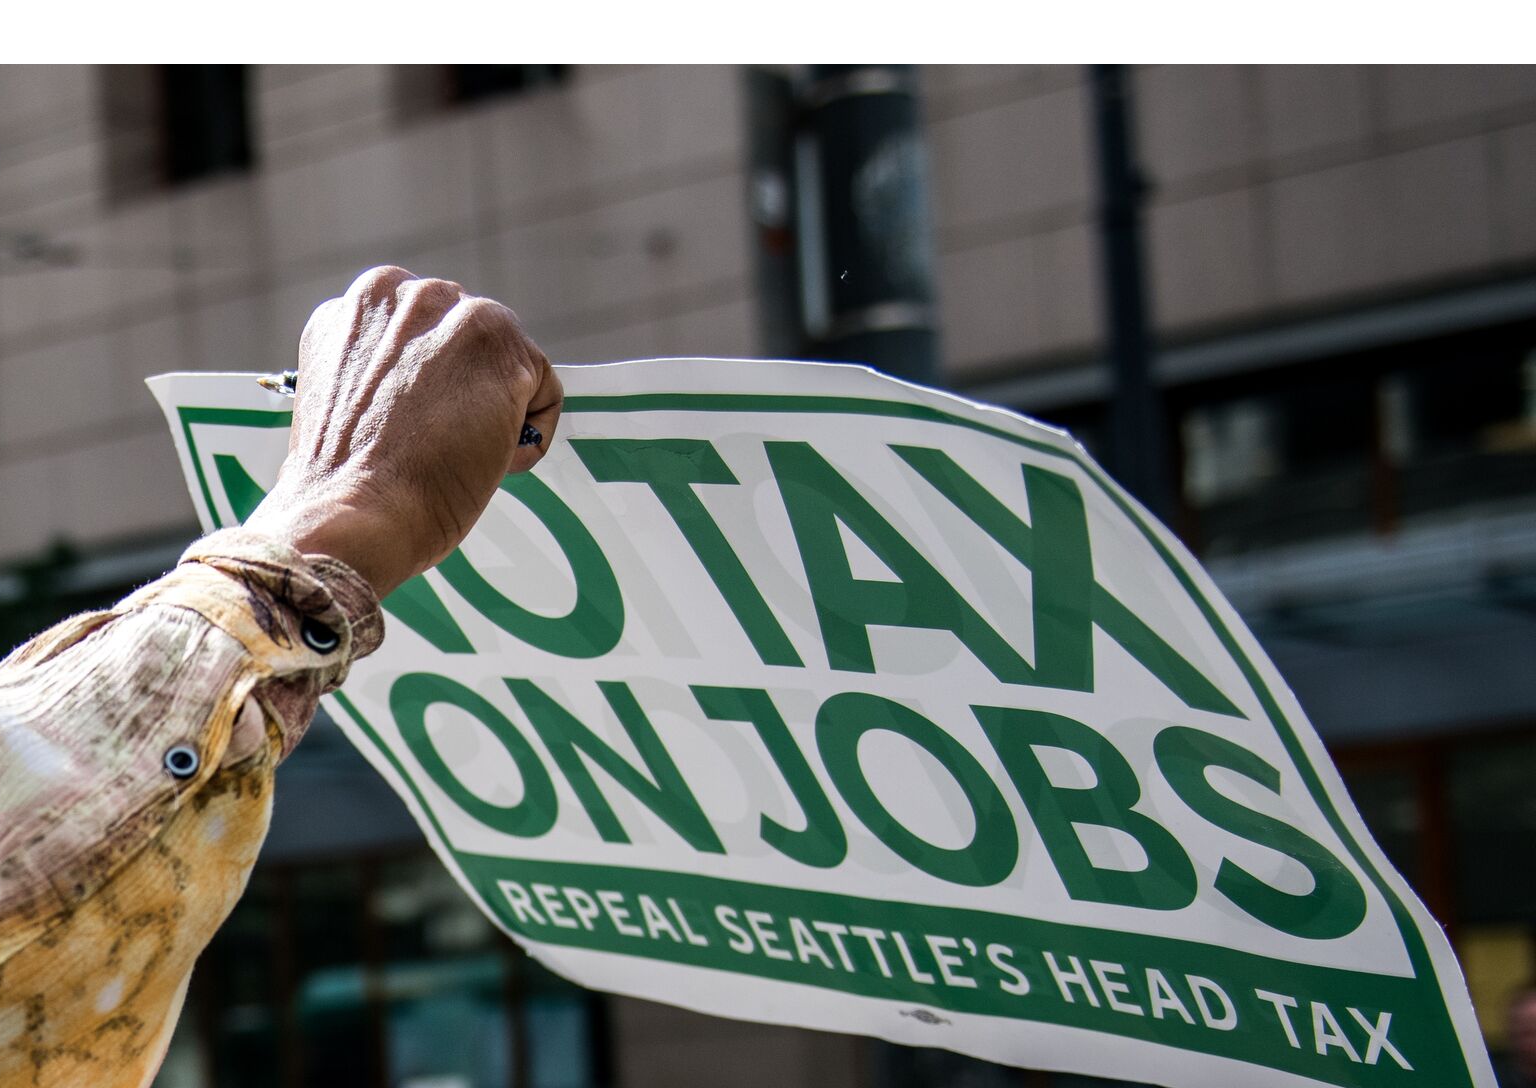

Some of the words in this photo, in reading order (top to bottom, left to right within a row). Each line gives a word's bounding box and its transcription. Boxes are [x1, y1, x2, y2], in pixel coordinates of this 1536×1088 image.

[568, 437, 1247, 720] TAX
[388, 671, 727, 854] ON
[690, 684, 1368, 941] JOBS
[496, 879, 710, 947] REPEAL
[714, 905, 1031, 996] SEATTLE'S
[1042, 951, 1238, 1031] HEAD
[1253, 987, 1415, 1072] TAX
